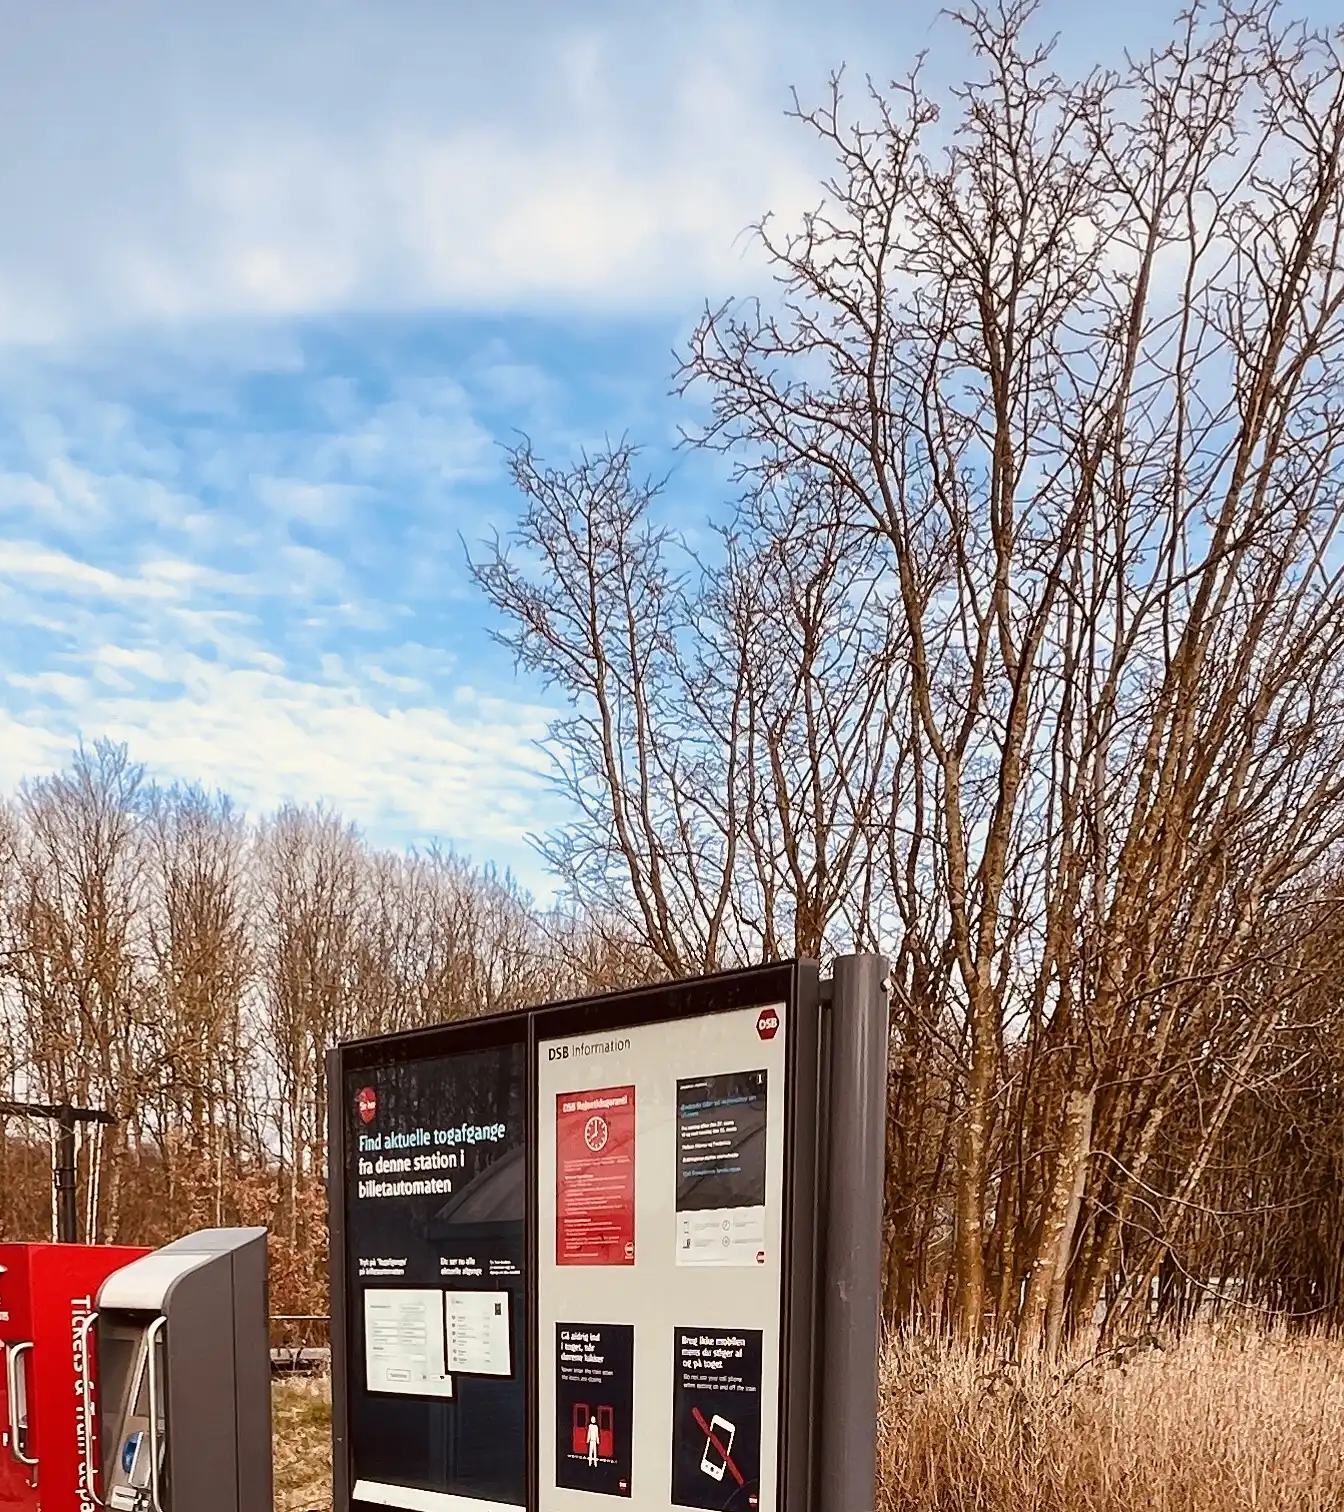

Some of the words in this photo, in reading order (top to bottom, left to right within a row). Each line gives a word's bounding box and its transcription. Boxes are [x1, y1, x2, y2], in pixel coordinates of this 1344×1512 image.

[758, 1018, 778, 1030] DSB
[548, 1046, 569, 1061] DSB
[359, 1133, 382, 1152] Find
[384, 1128, 431, 1149] aktuelle
[434, 1122, 506, 1146] togafgange
[358, 1157, 373, 1175] fra
[375, 1155, 412, 1173] denne
[414, 1150, 457, 1171] station
[460, 1149, 465, 1168] i
[358, 1178, 452, 1199] billetautomaten
